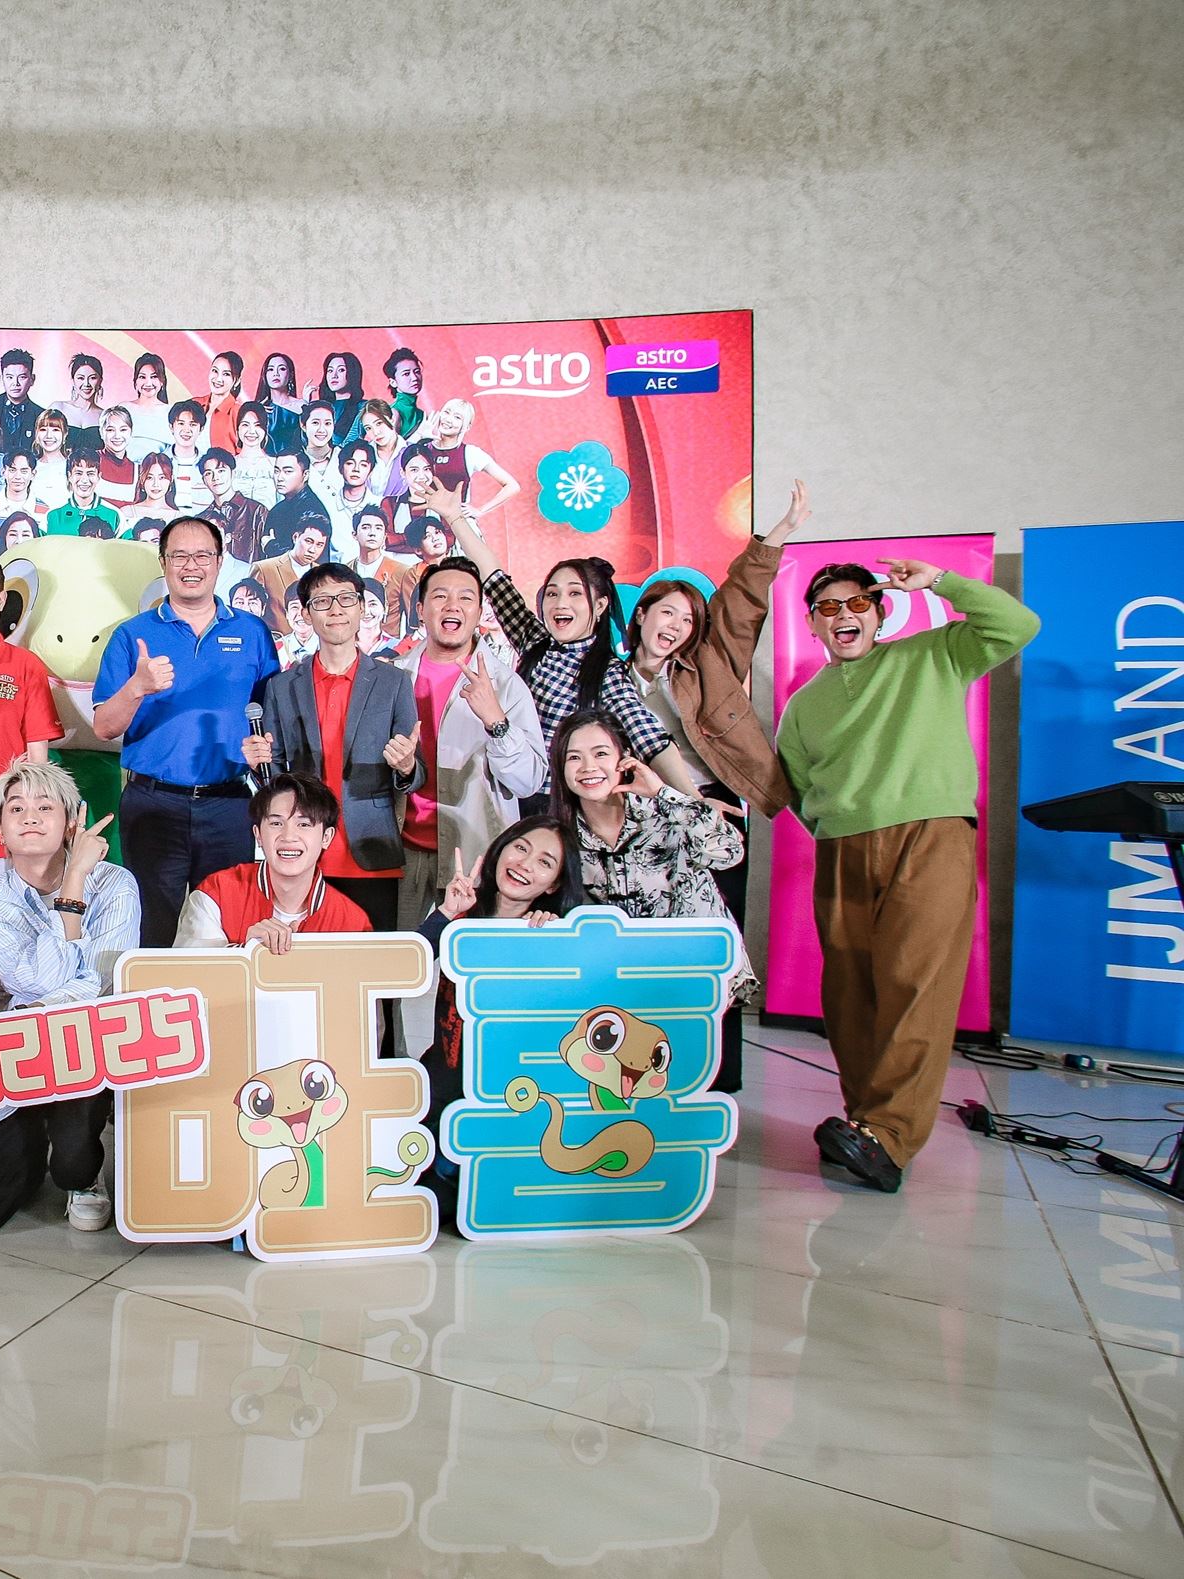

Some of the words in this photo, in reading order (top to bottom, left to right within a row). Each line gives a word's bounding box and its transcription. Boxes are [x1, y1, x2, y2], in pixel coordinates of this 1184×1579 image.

[472, 347, 591, 388] astro
[635, 347, 688, 365] astro
[645, 377, 678, 390] AEC
[1111, 595, 1184, 782] AND
[122, 939, 433, 1252] 旺
[451, 913, 734, 1233] 喜
